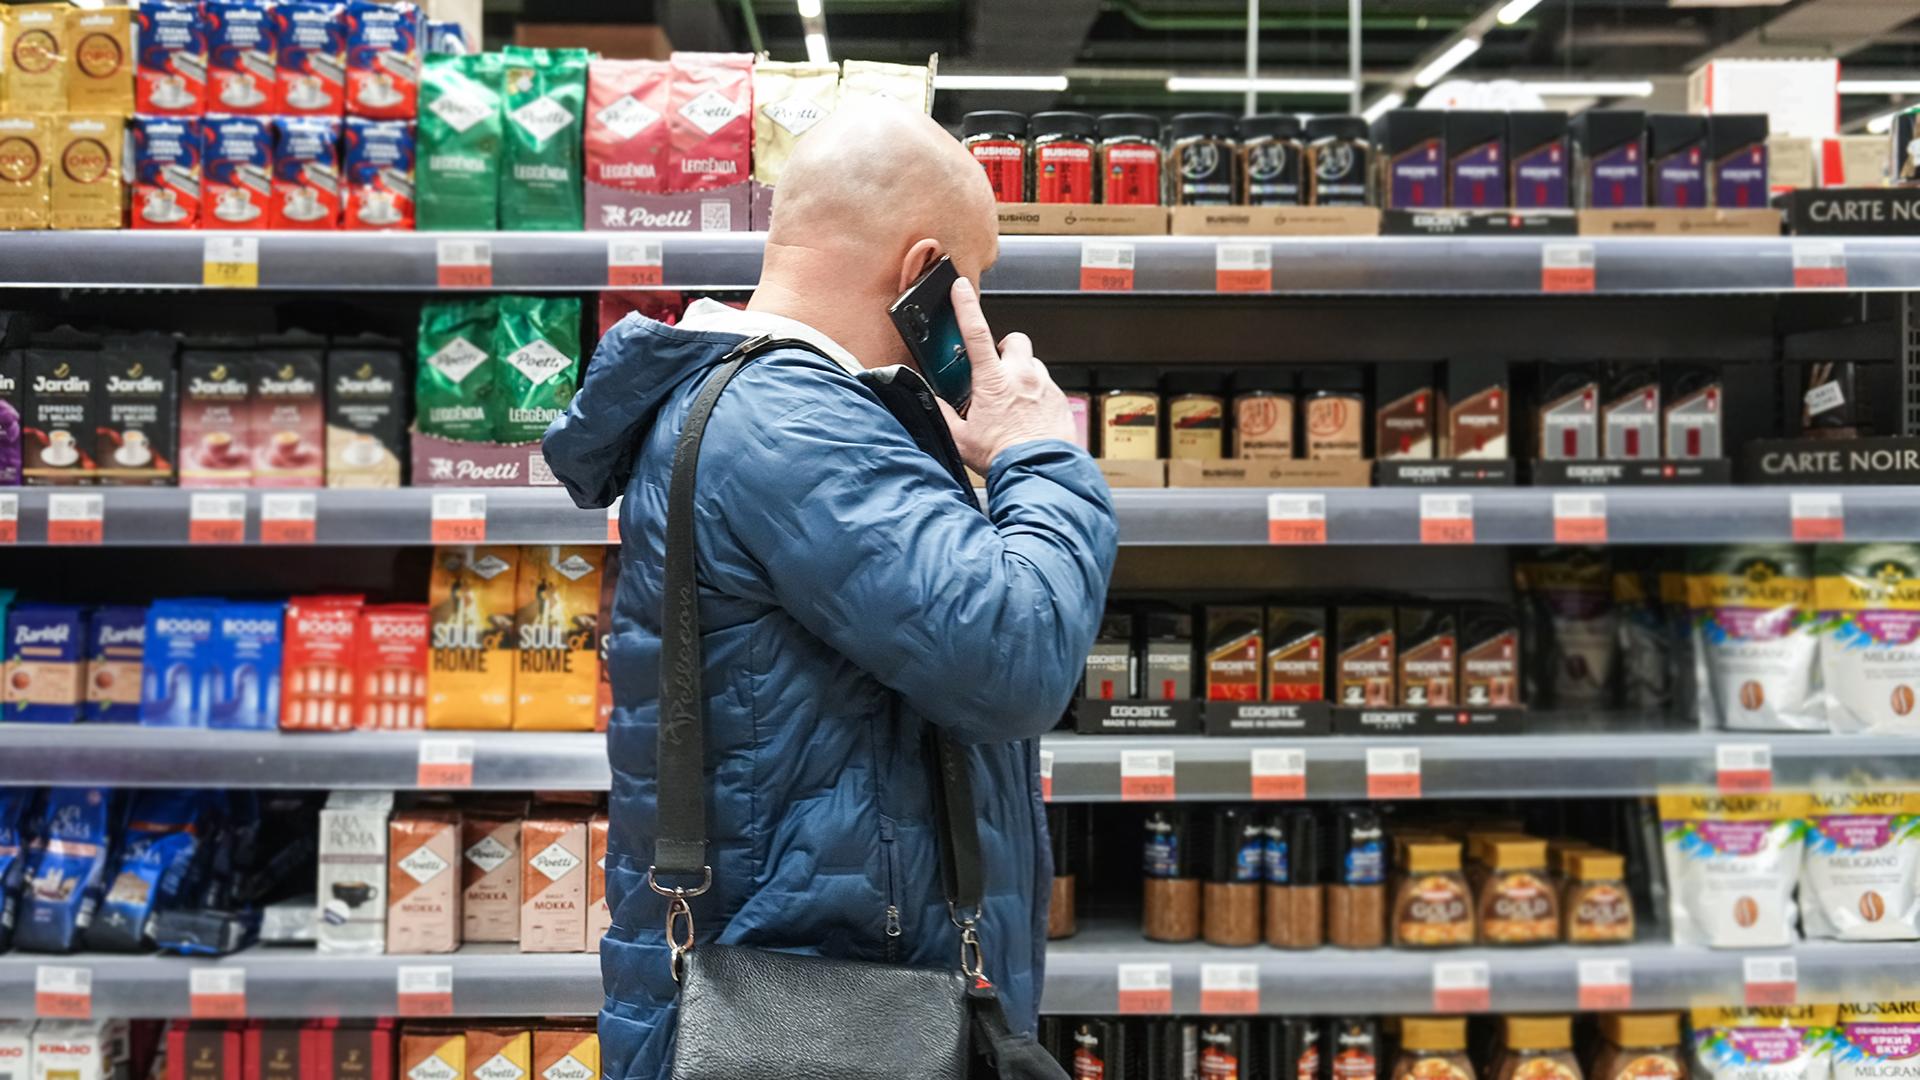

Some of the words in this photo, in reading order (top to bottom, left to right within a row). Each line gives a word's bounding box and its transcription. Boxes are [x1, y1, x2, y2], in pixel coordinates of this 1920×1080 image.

[629, 206, 693, 228] Poetti
[1809, 201, 1885, 221] CARTE
[516, 351, 562, 369] Poetti
[33, 376, 90, 393] Jardin
[106, 376, 163, 393] Jardin
[189, 378, 248, 394] Jardin
[258, 377, 315, 394] Jardin
[336, 376, 393, 393] Jardin
[456, 459, 520, 480] Poetti
[1761, 451, 1842, 474] CARTE
[1850, 449, 1920, 471] NOIR
[1710, 584, 1809, 603] MONARCH
[156, 618, 210, 634] BOGGI
[222, 618, 277, 634] BOGGI
[298, 619, 353, 634] BOGGI
[370, 622, 425, 638] BOGGI
[433, 622, 482, 648] SOUL
[483, 630, 504, 650] of
[519, 622, 567, 648] SOUL
[568, 630, 589, 651] of
[433, 649, 488, 672] ROME
[520, 649, 573, 673] ROME
[1110, 705, 1170, 718] EGOISTE
[1238, 706, 1300, 718] EGOISTE
[1102, 719, 1126, 728] MADE
[1127, 719, 1136, 728] IN
[1137, 719, 1176, 728] GERMANY
[1230, 719, 1254, 729] MADE
[1255, 719, 1263, 729] IN
[1264, 719, 1305, 729] GERMANY
[1691, 797, 1781, 812] MONARCH
[1810, 793, 1904, 808] MONARCH
[329, 831, 376, 848] ROMA
[468, 847, 506, 860] Poetti
[537, 855, 573, 869] Poetti
[468, 891, 508, 902] MOKKA
[401, 903, 443, 914] MOKKA
[534, 900, 575, 911] MOKKA
[1411, 901, 1464, 917] GOLD
[1495, 898, 1547, 916] GOLD
[1579, 901, 1630, 918] GOLD
[1719, 1005, 1814, 1019] MONARCH
[1871, 1035, 1912, 1046] ЯРКИЙ
[1876, 1045, 1909, 1054] ВКУС
[416, 1067, 450, 1080] Poetti
[478, 1066, 516, 1080] Poetti
[550, 1066, 586, 1080] Poetti
